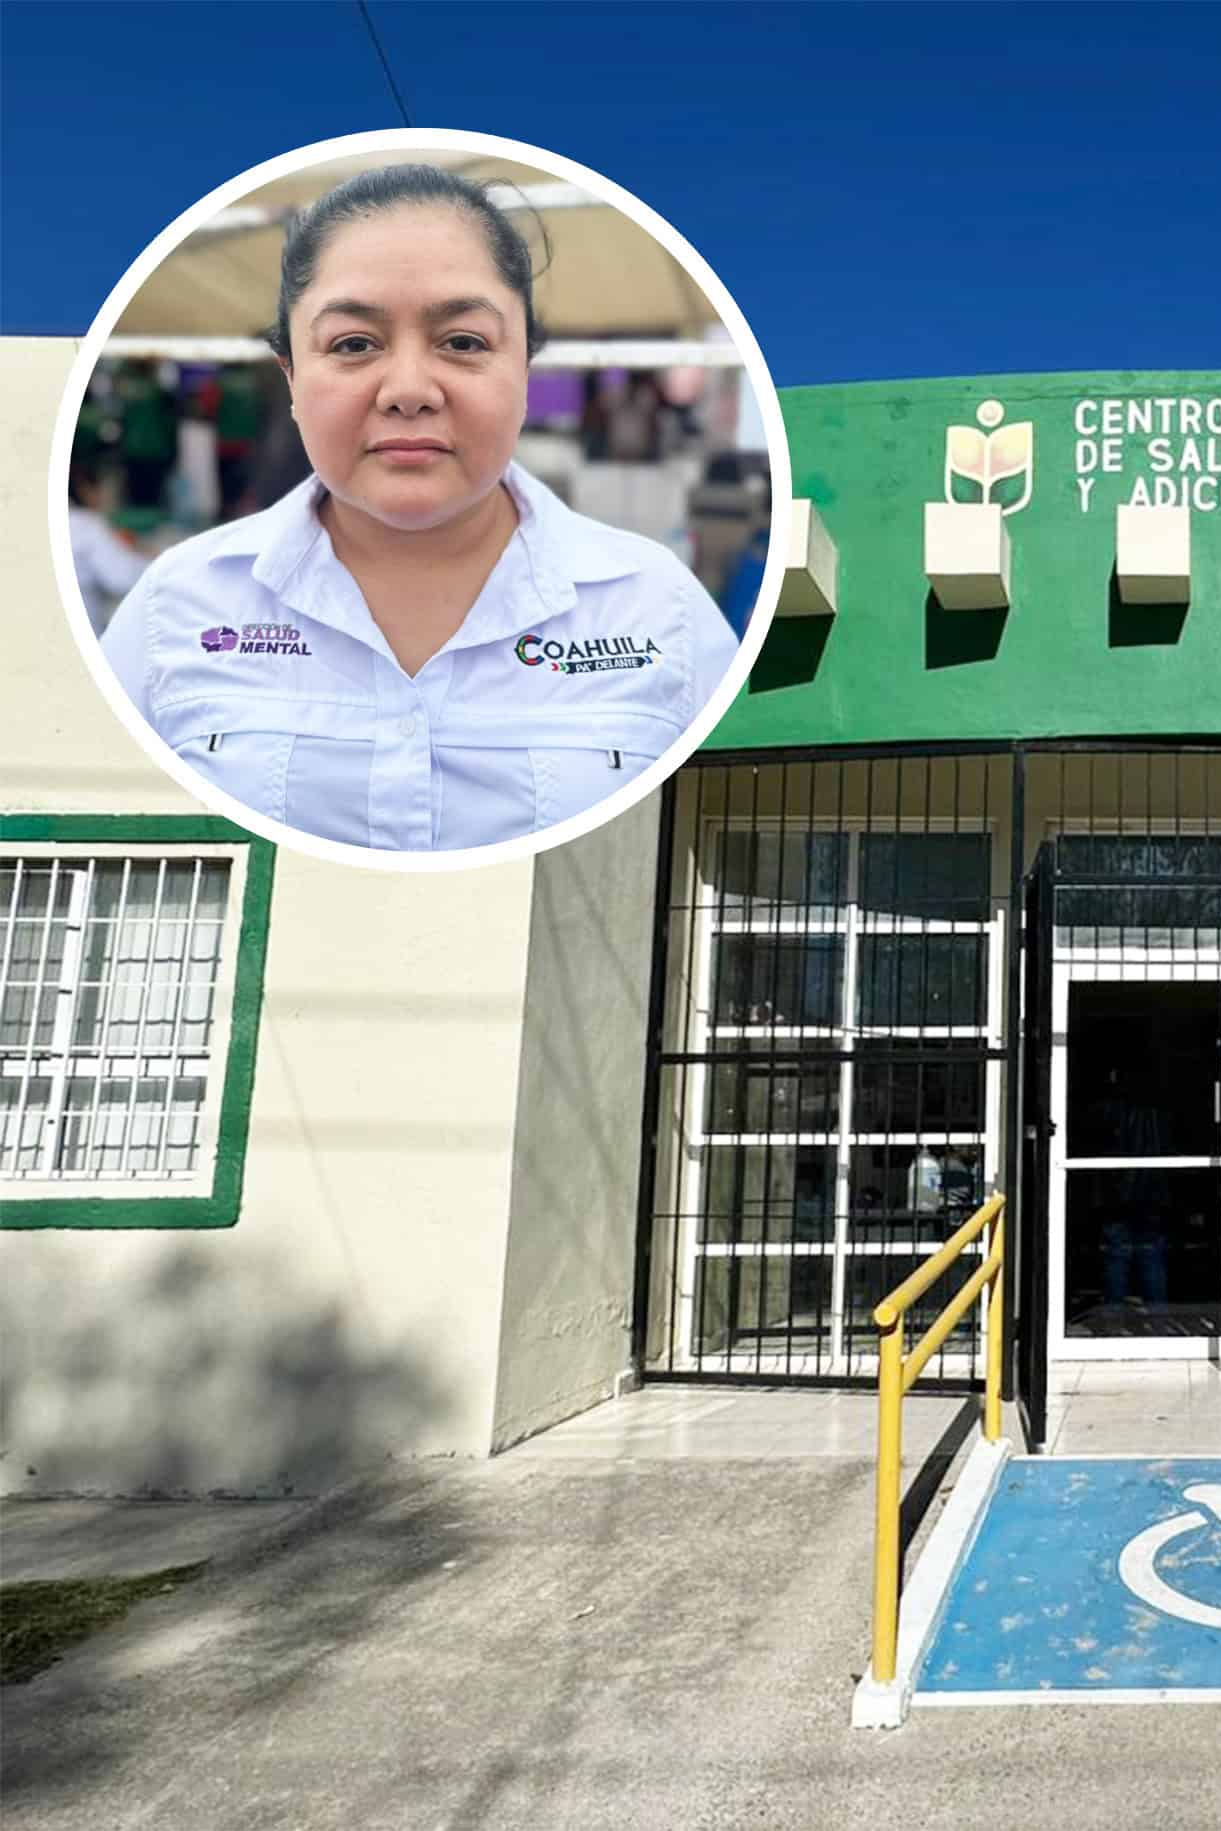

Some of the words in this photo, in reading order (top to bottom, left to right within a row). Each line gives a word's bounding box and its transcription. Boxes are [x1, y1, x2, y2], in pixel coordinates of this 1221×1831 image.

[1074, 438, 1123, 473] DE
[1077, 478, 1095, 513] Y
[242, 629, 300, 641] SALUD
[239, 641, 312, 656] MENTAL
[514, 634, 663, 666] COAHUILA
[595, 657, 640, 671] DELANTE
